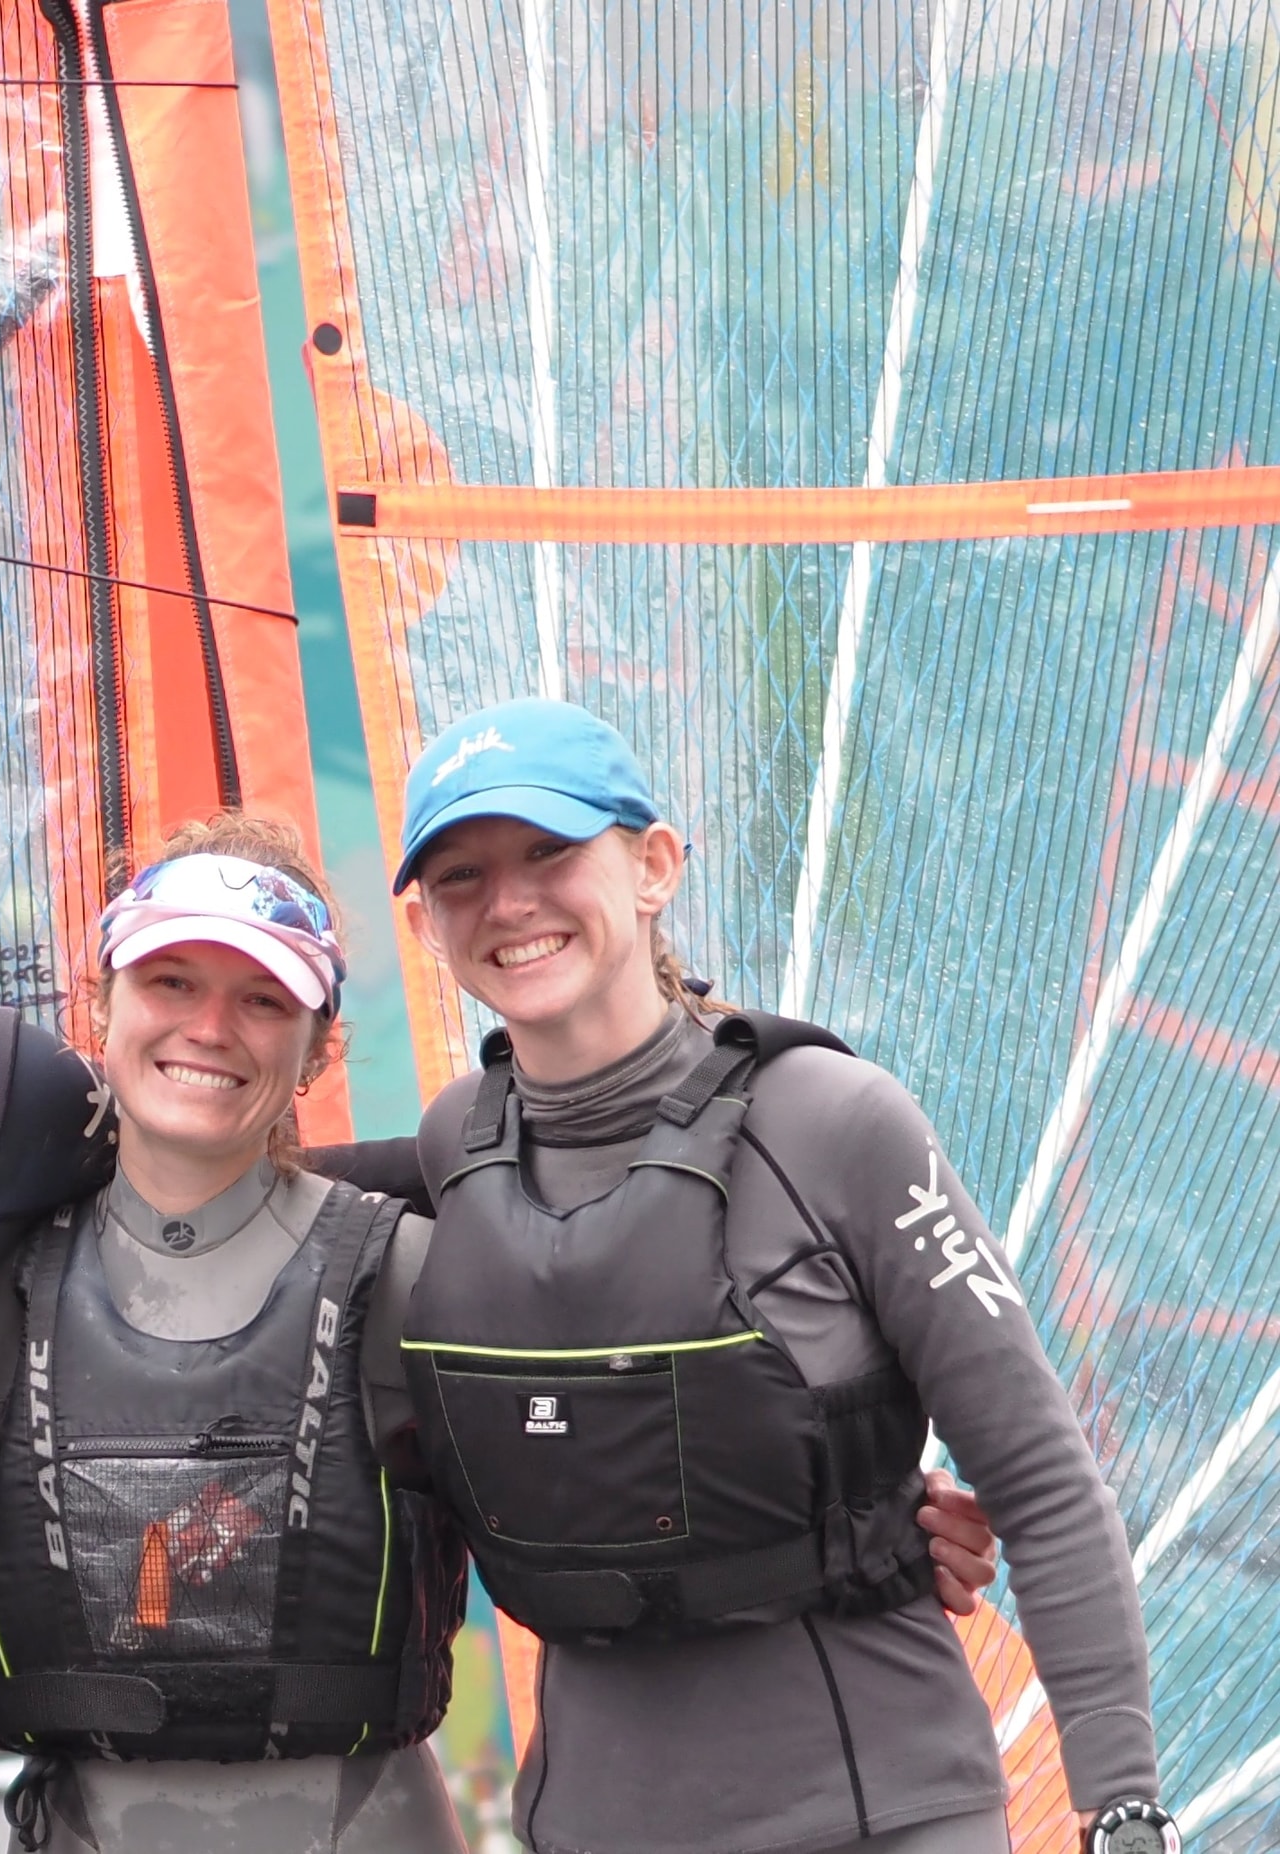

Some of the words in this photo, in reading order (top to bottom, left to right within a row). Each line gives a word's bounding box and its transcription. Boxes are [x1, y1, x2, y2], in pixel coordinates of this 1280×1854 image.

[431, 726, 516, 788] zhik
[895, 1150, 1023, 1317] zhik
[30, 1340, 69, 1570] BALTIC
[289, 1297, 339, 1530] BALTIC
[526, 1421, 567, 1431] BALTIC
